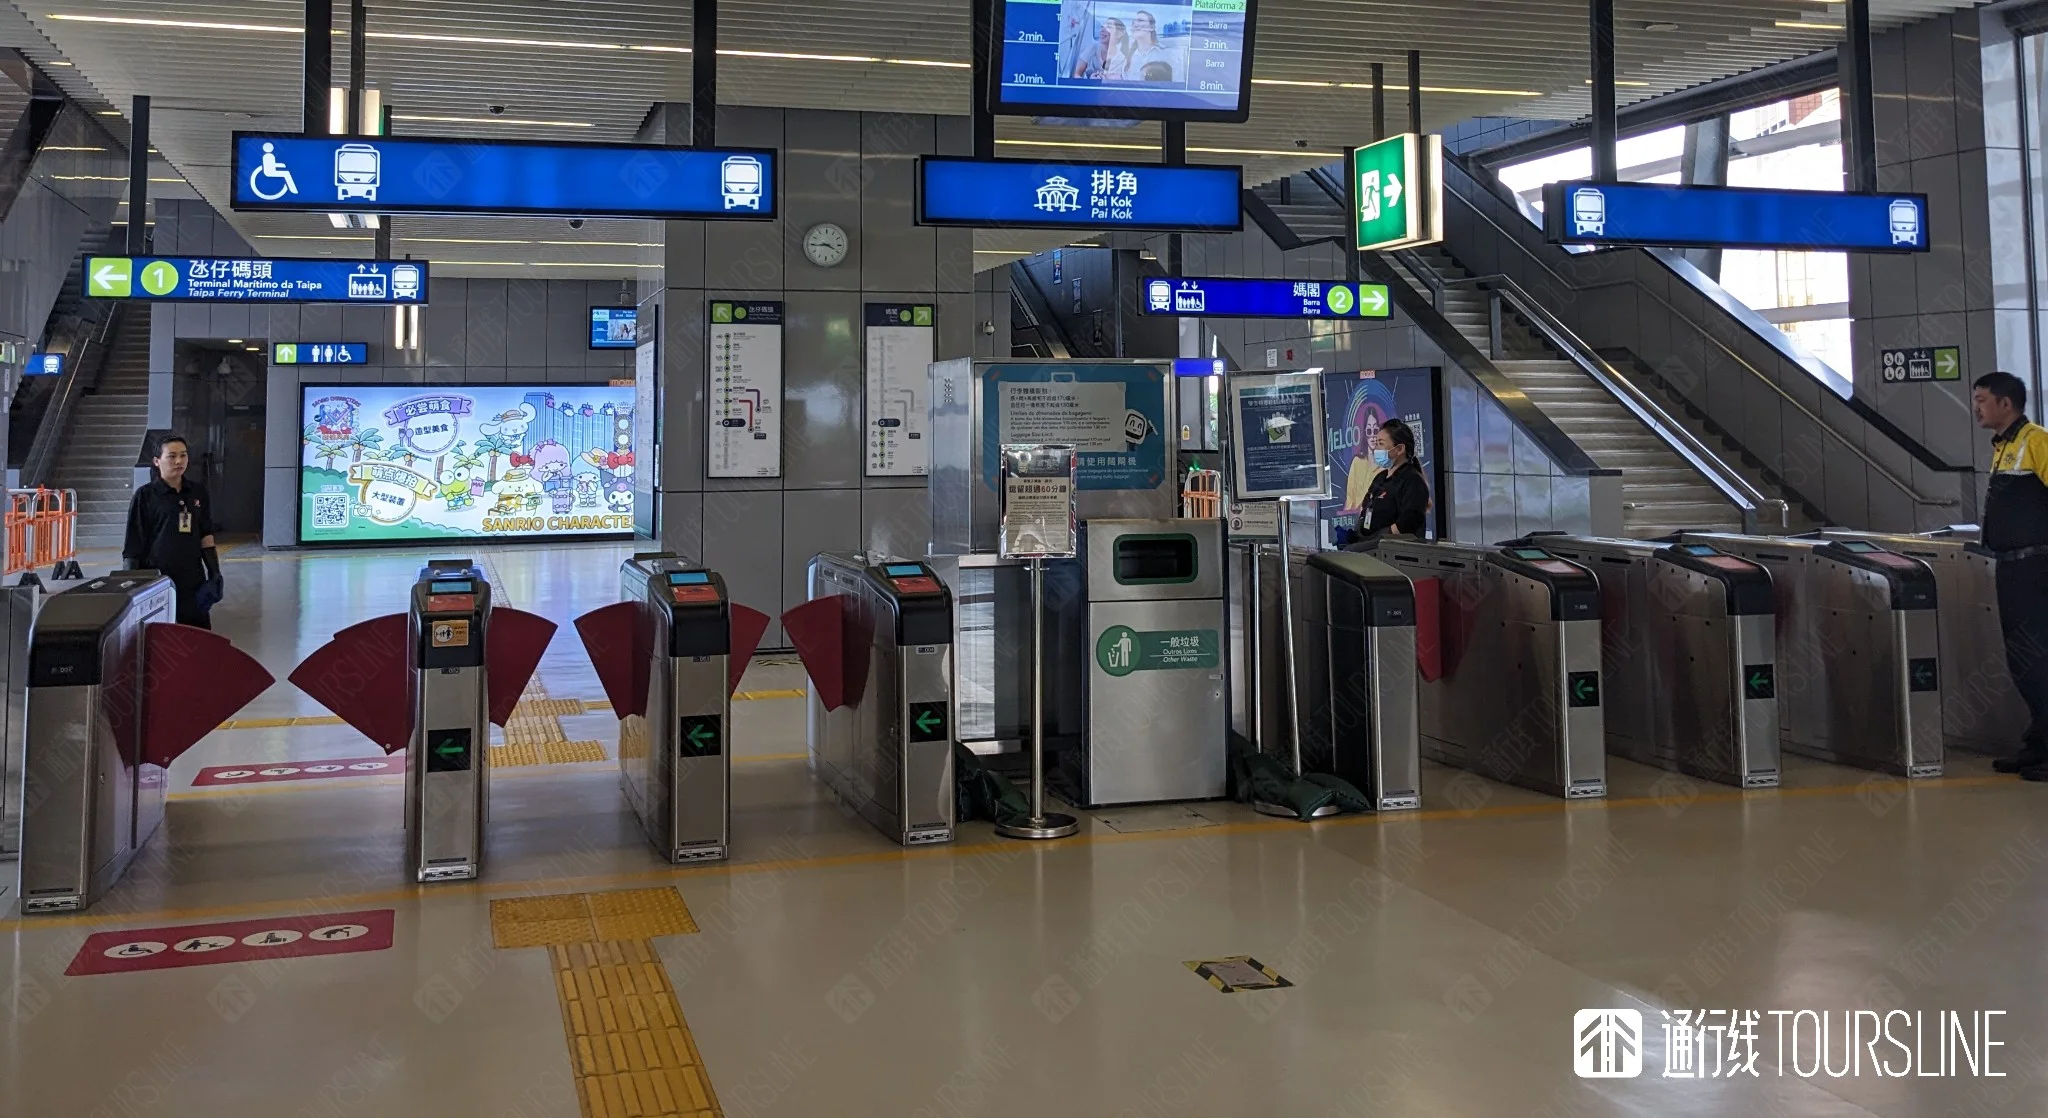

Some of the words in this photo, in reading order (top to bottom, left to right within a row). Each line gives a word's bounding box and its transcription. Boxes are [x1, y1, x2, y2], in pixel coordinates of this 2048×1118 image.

[1195, 0, 1236, 10] Plataforma
[1208, 20, 1228, 30] Barra
[1205, 59, 1225, 69] Barra
[1091, 170, 1138, 195] 排角
[1090, 196, 1107, 206] Pai
[1111, 196, 1132, 207] Kok
[1091, 208, 1108, 218] Pai
[1111, 208, 1133, 219] Kok
[188, 260, 273, 279] 氹仔碼頭
[152, 268, 164, 288] 1
[188, 279, 231, 288] Terminal
[233, 279, 279, 289] Marítimo
[280, 281, 294, 289] da
[296, 281, 322, 290] Taipa
[1293, 282, 1320, 297] 媽閣
[188, 288, 215, 298] Taipa
[216, 289, 244, 298] Ferry
[247, 289, 289, 298] Terminal
[1335, 291, 1346, 308] 2
[1303, 306, 1320, 314] Barra
[414, 423, 448, 436] 造型美食
[482, 517, 544, 532] SANRIO
[547, 514, 634, 530] CHARACTE
[1160, 637, 1199, 647] 一般垃圾
